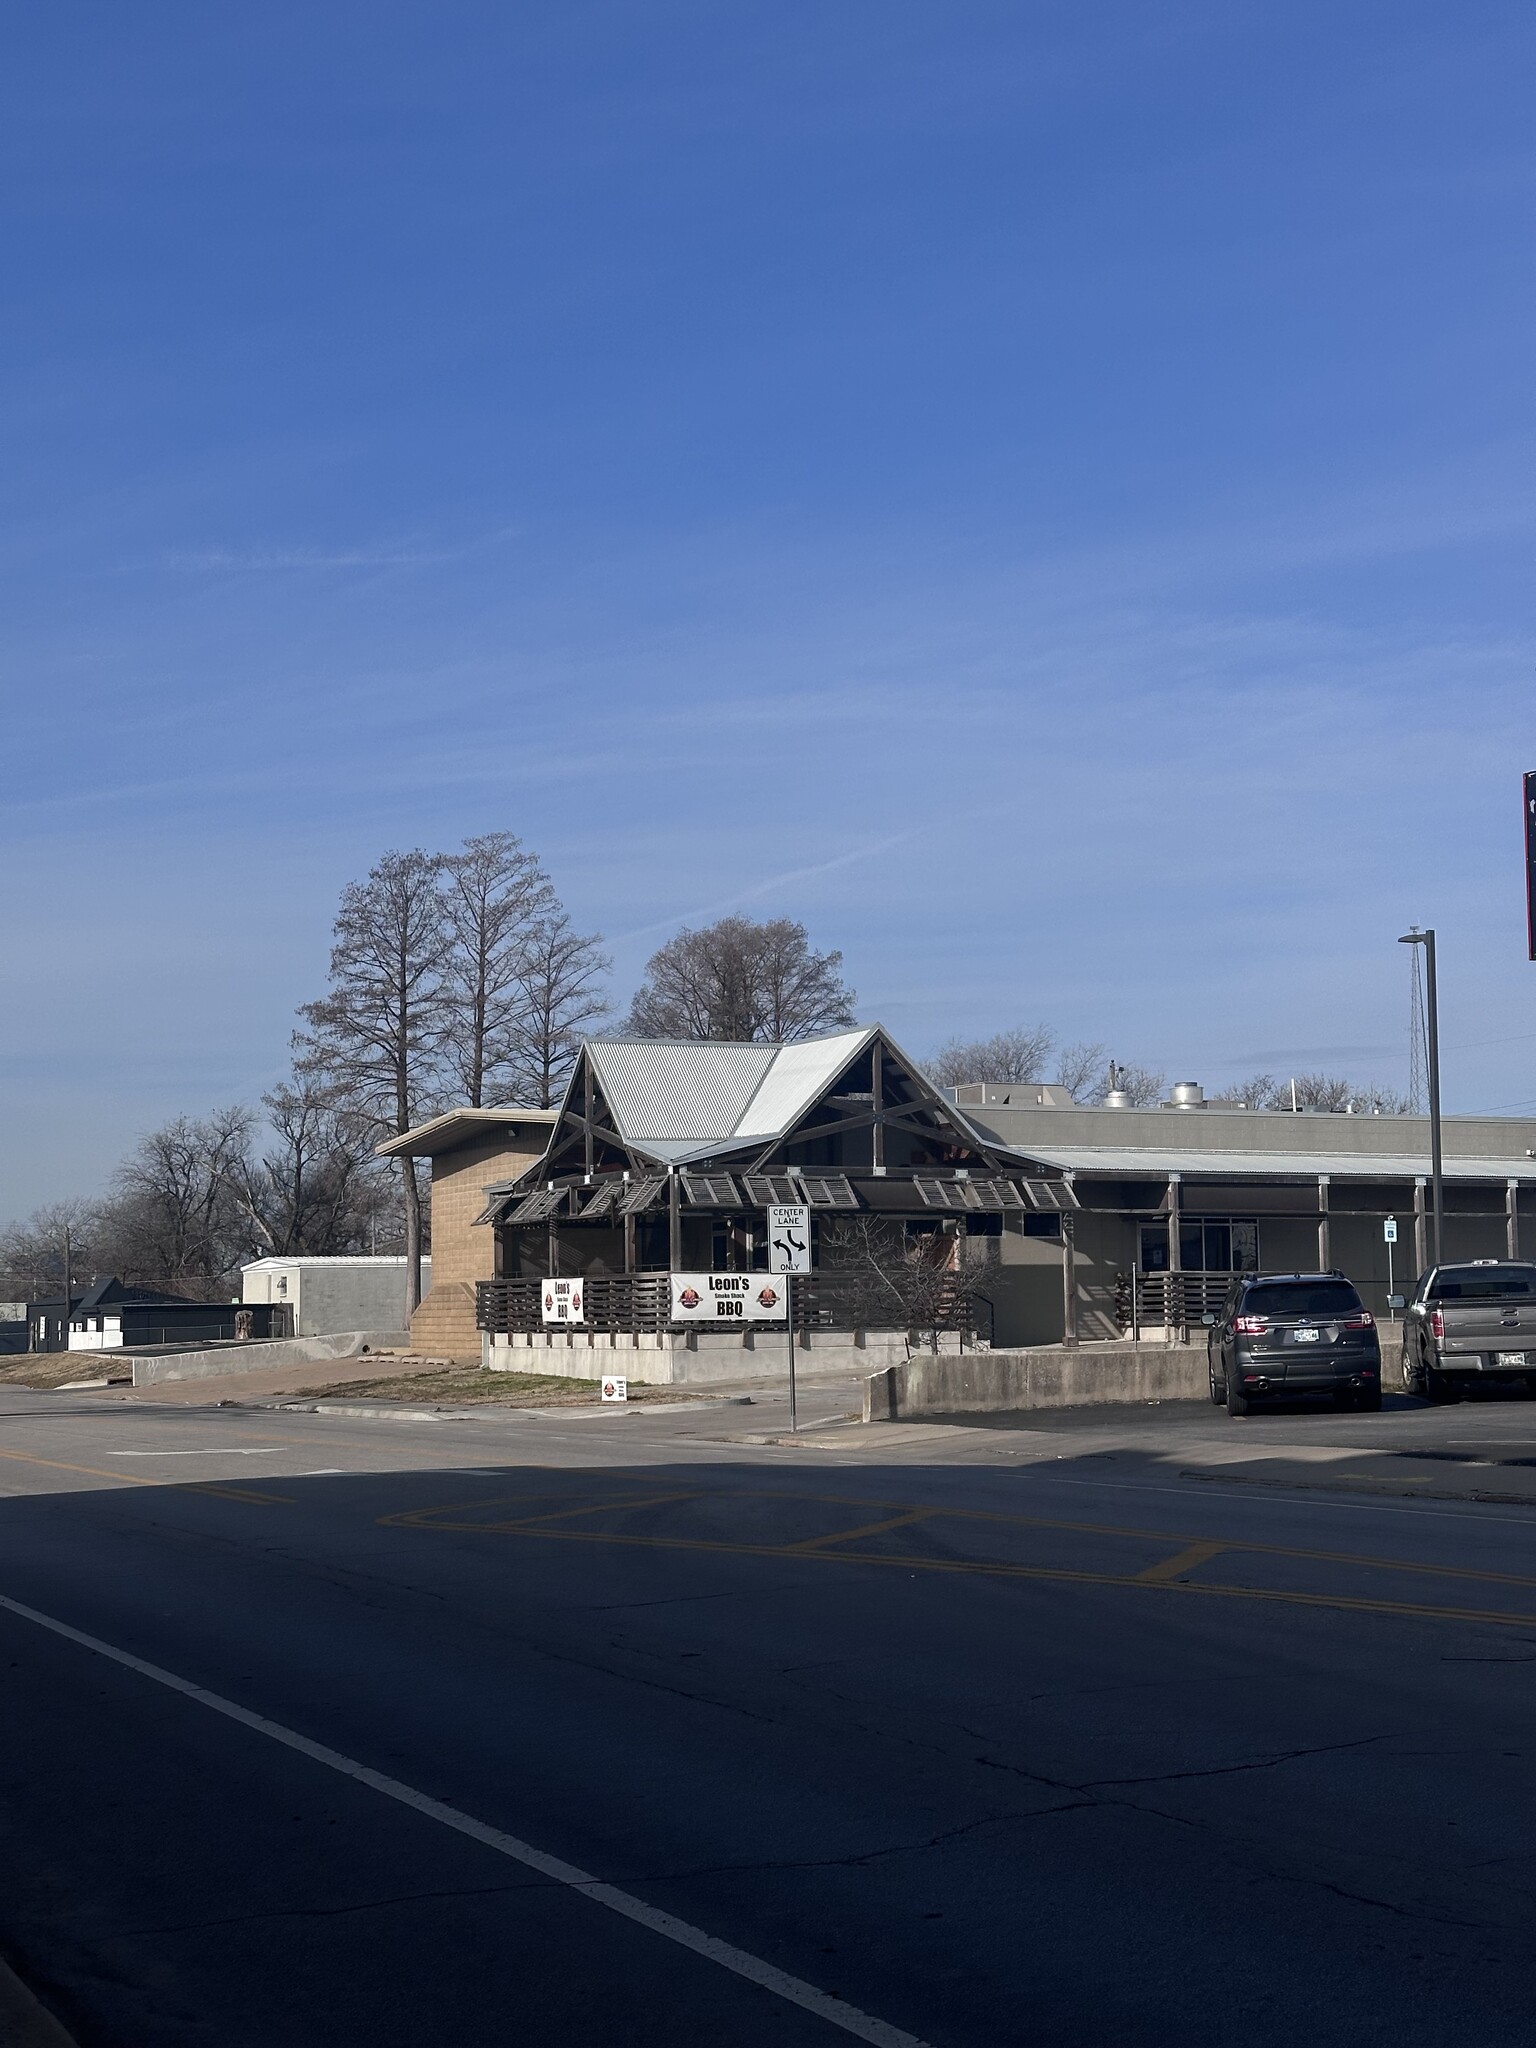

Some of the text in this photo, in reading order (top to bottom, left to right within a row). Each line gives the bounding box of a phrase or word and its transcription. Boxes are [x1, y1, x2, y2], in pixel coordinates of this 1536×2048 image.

[773, 1208, 804, 1216] CENTER
[708, 1276, 750, 1290] Leon's
[717, 1301, 743, 1317] BBQ
